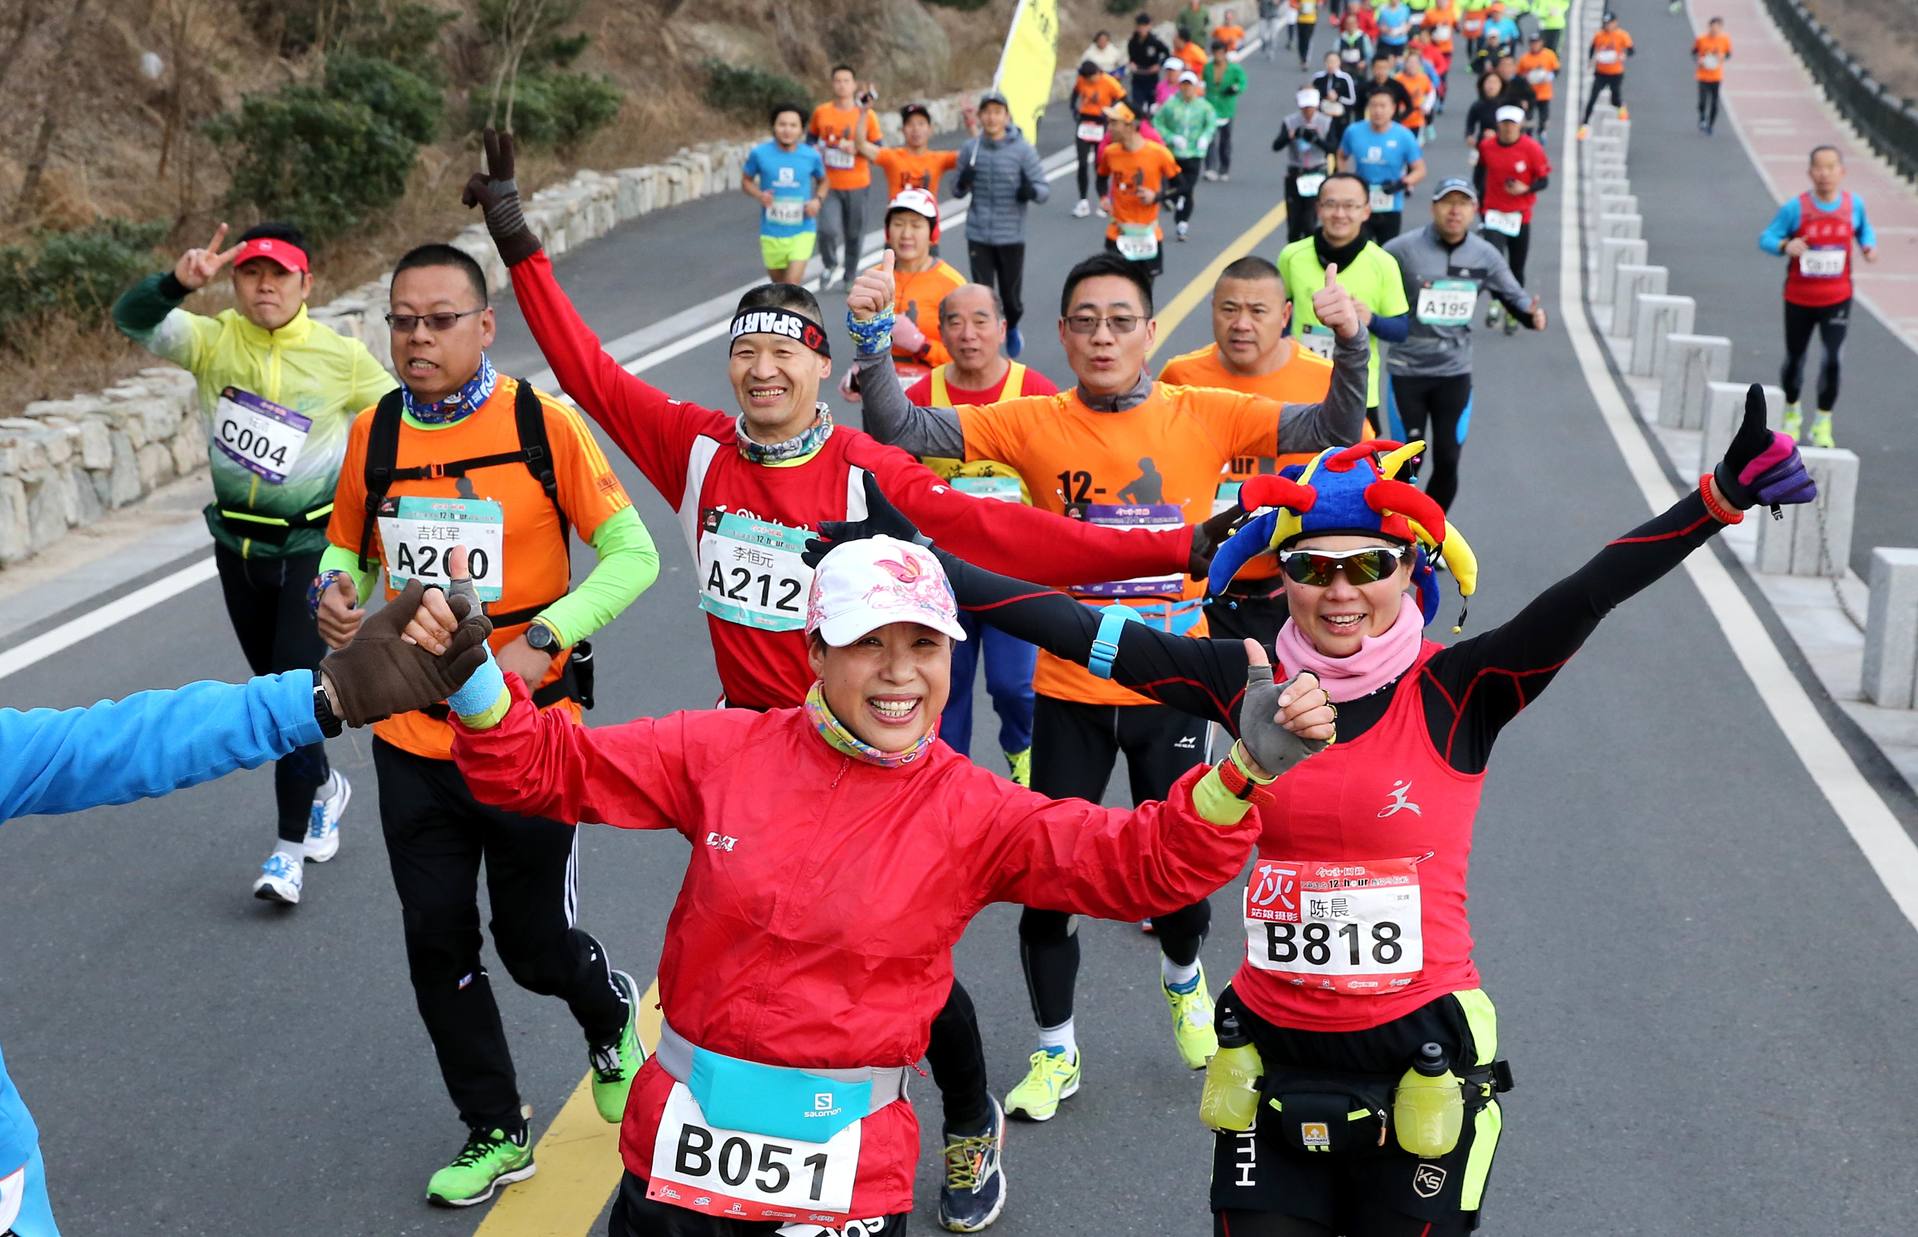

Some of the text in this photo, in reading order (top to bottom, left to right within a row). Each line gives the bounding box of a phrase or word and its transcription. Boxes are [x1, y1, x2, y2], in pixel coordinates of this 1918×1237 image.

[1424, 300, 1468, 316] A195
[222, 419, 288, 467] C004
[417, 525, 461, 542] 吉红军
[733, 546, 774, 569] 李恒元
[707, 560, 802, 612] A212
[1250, 864, 1297, 910] 灰
[1250, 908, 1299, 922] 姑娘摄影
[1310, 898, 1350, 919] 陈晨
[1264, 921, 1403, 966] B818
[674, 1122, 829, 1202] B051
[1417, 1170, 1442, 1190] KS
